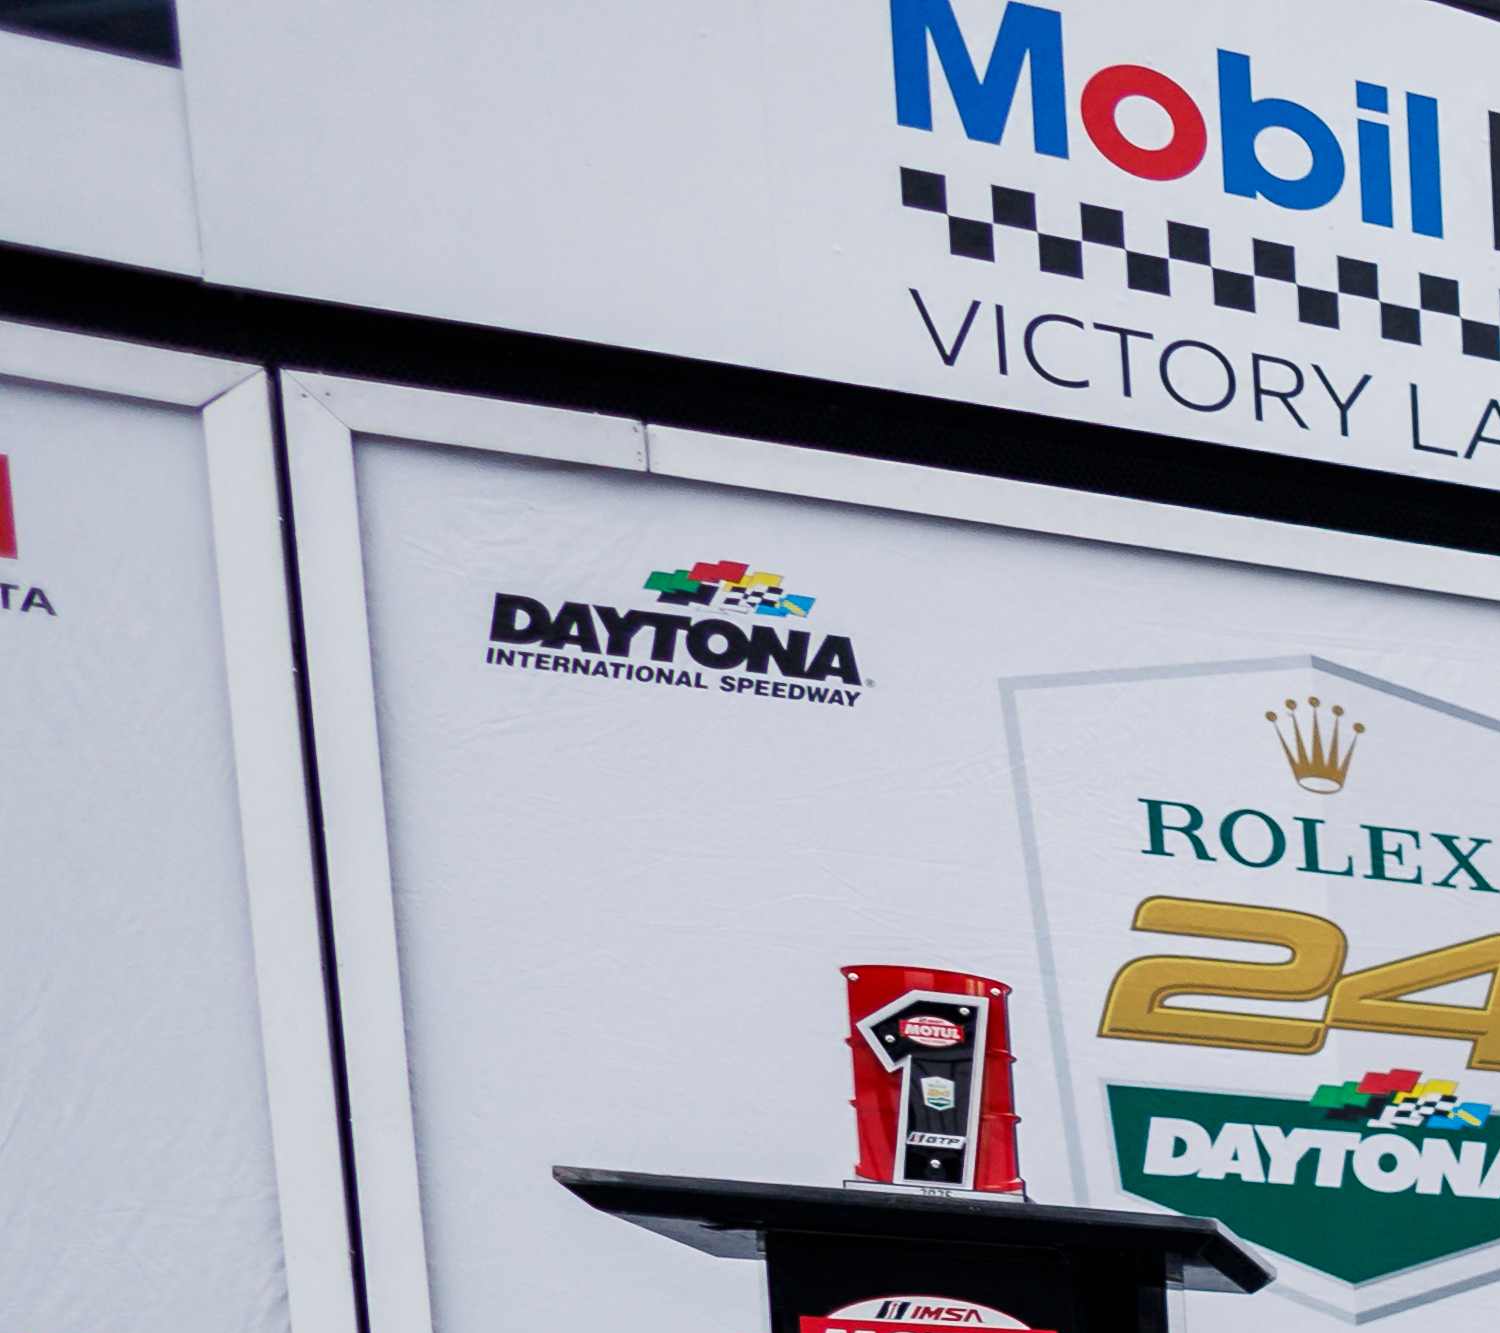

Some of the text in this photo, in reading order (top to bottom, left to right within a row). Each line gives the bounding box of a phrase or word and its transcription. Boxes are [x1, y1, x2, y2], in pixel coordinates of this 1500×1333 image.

[890, 0, 1444, 239] Mobil
[909, 287, 1373, 437] VICTORY
[486, 647, 861, 708] INTERNATIONAL SPEEDWAY
[490, 592, 862, 687] DAYTONA
[1137, 798, 1500, 894] ROLEX
[904, 1022, 961, 1041] MOTUL
[911, 1305, 984, 1323] IMSA
